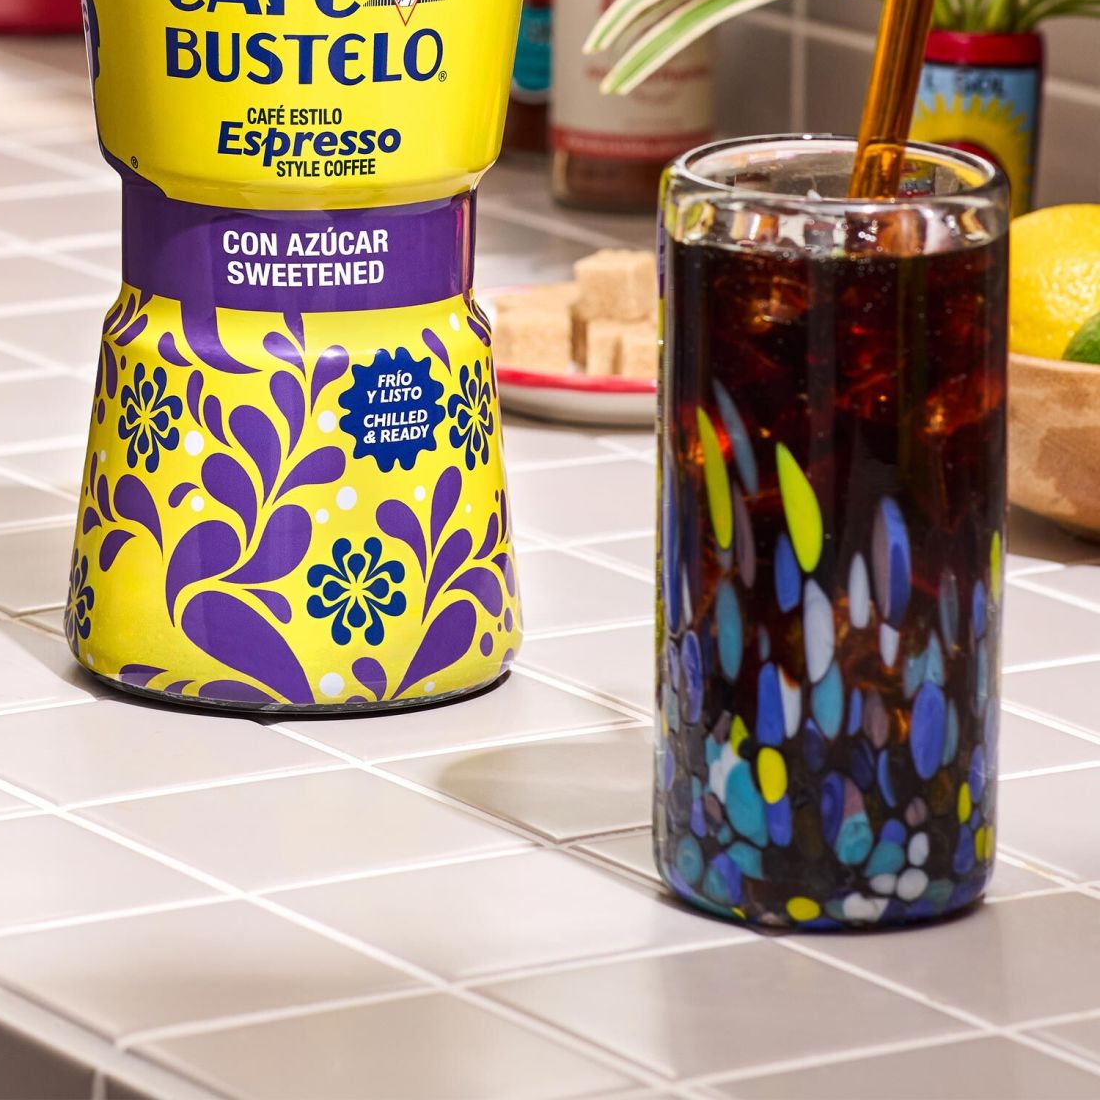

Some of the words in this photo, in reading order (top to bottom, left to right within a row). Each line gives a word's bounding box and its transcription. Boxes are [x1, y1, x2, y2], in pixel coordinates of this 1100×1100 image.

[165, 27, 444, 85] BUSTELO
[247, 105, 285, 125] CAFÉ
[290, 108, 342, 125] ESTILO
[217, 121, 401, 167] Espresso
[277, 160, 320, 177] STYLE
[324, 159, 376, 176] COFFEE
[222, 230, 277, 256] CON
[286, 227, 389, 256] AZÚCAR
[227, 260, 385, 287] SWEETENED
[378, 370, 413, 388] FRÍO
[367, 390, 377, 404] Y
[380, 386, 422, 403] LISTO
[363, 409, 428, 428] CHILLED
[363, 430, 376, 444] &
[380, 424, 430, 443] READY
